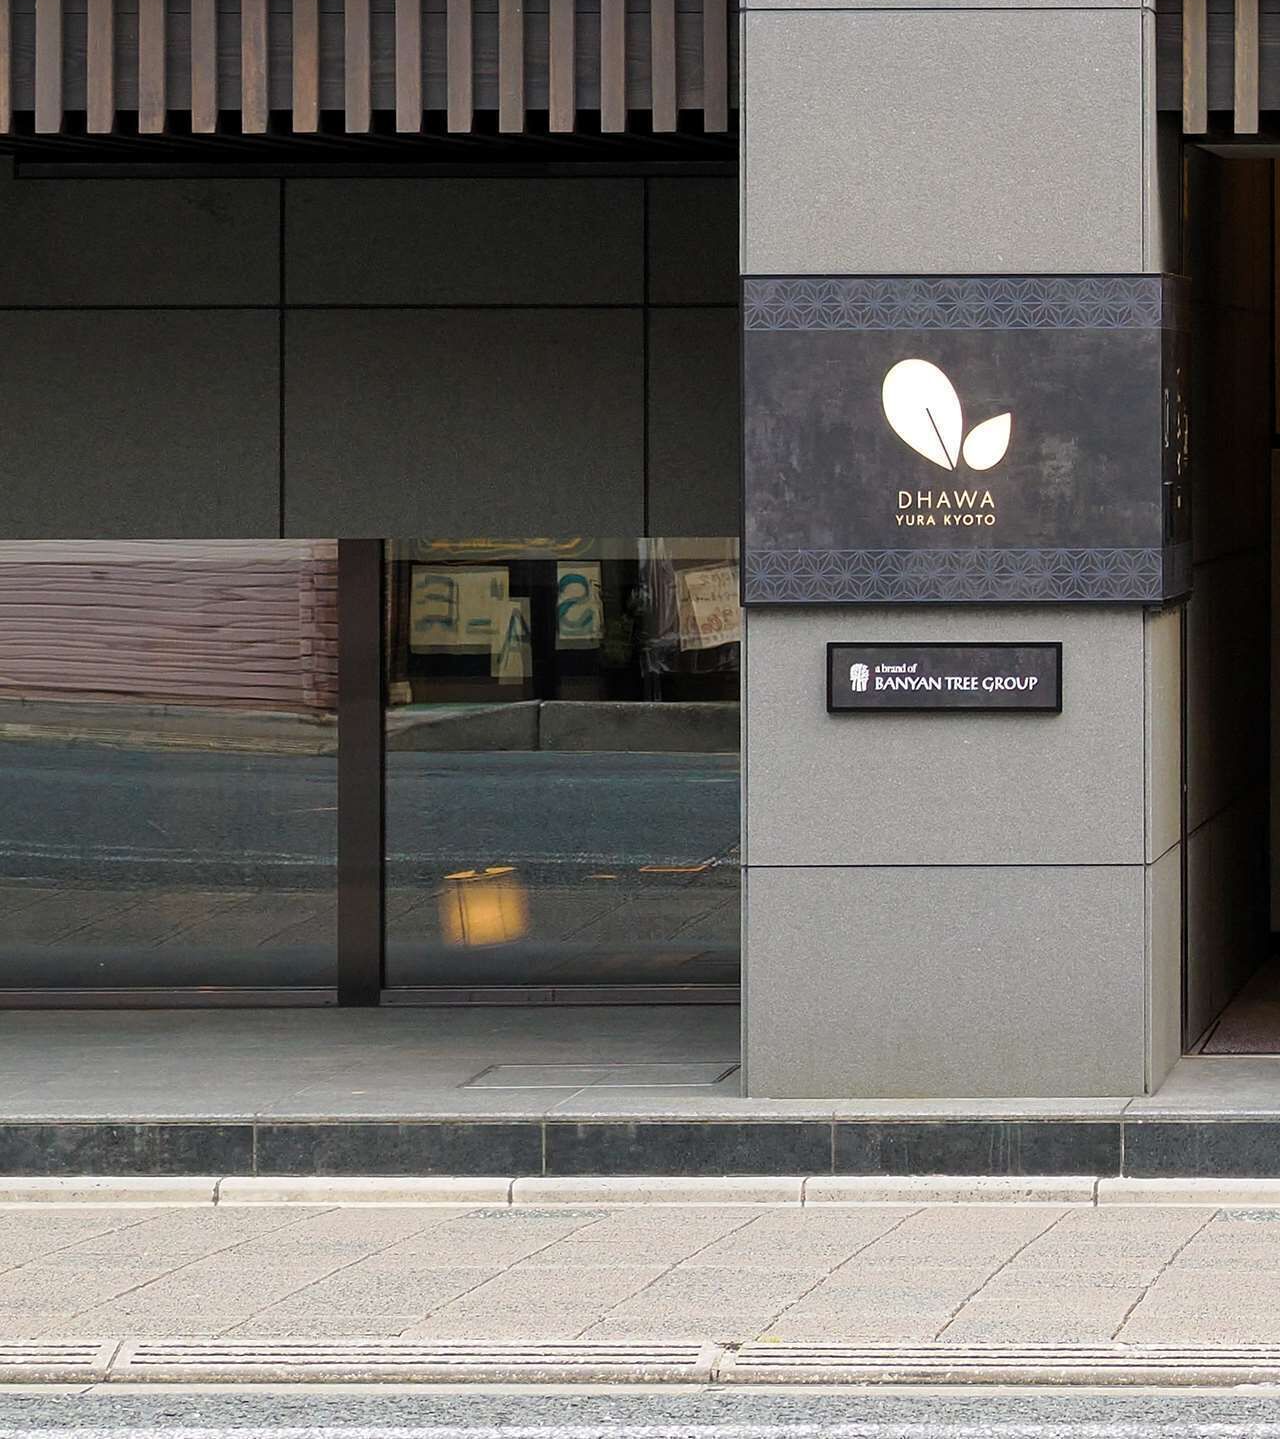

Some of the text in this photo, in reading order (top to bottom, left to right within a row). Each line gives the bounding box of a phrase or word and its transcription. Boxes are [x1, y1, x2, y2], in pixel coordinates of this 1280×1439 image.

[898, 489, 996, 510] DHAWA
[895, 513, 996, 527] YURA KYOTO
[874, 663, 918, 674] a brand of
[874, 676, 1039, 693] BANYAN TREE GROUP
